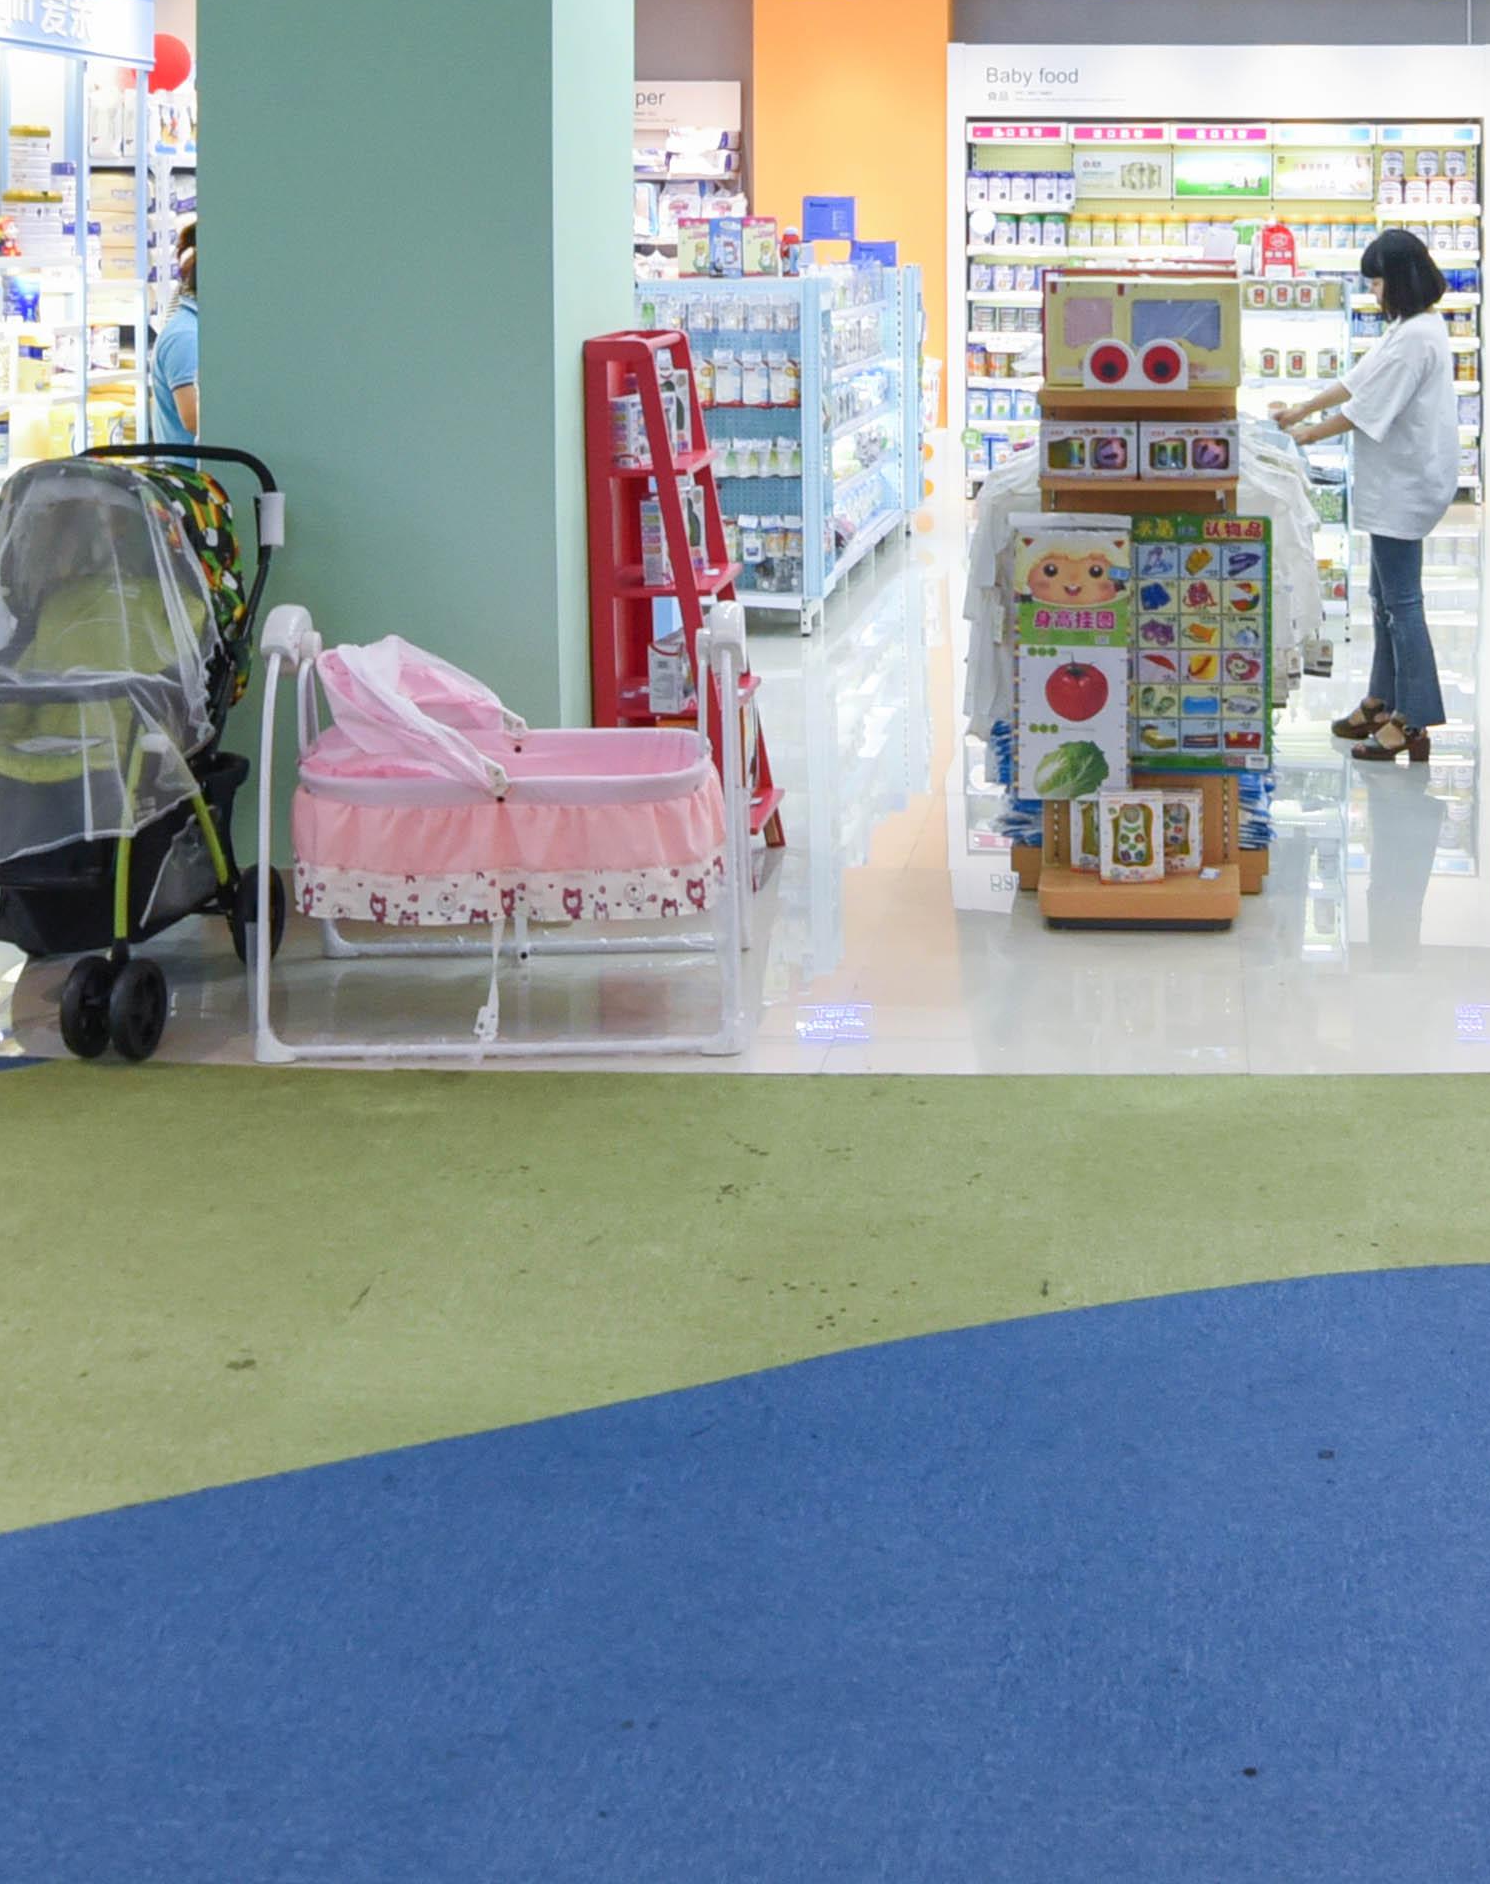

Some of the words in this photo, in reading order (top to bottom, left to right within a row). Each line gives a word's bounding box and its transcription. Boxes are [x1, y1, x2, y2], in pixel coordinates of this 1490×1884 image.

[986, 67, 1032, 88] Baby
[1039, 67, 1079, 85] food
[1033, 609, 1116, 631] 身高挂图
